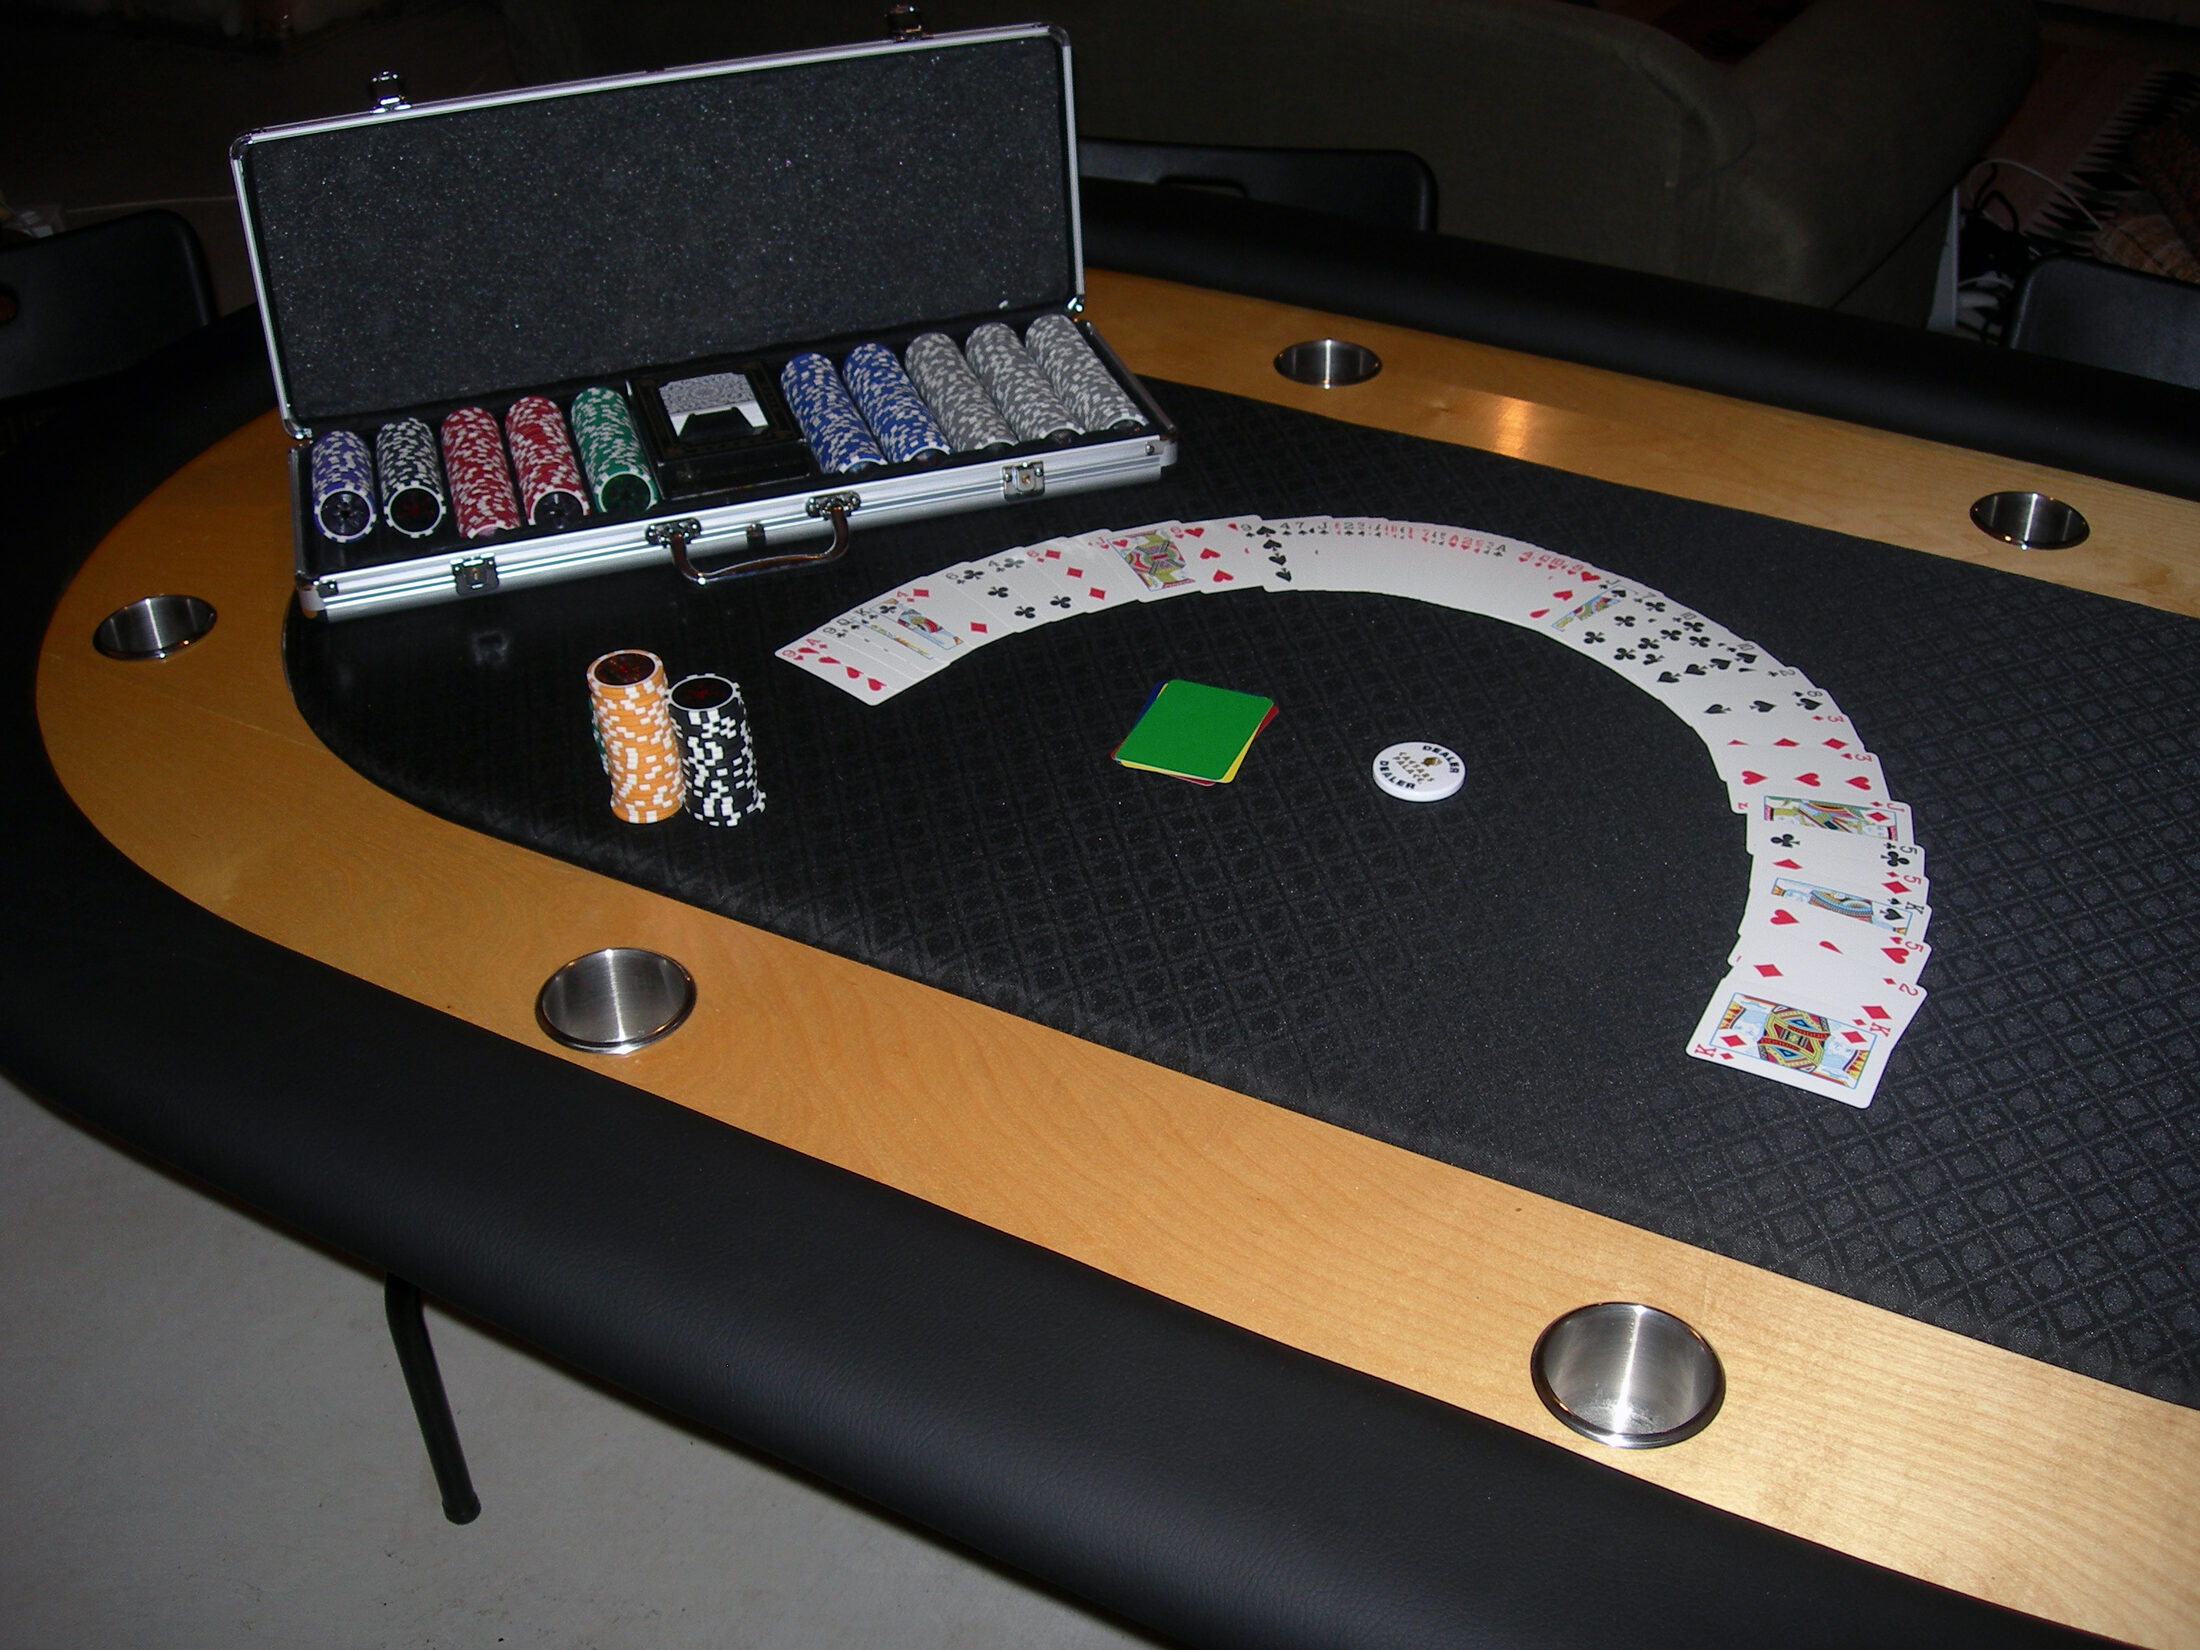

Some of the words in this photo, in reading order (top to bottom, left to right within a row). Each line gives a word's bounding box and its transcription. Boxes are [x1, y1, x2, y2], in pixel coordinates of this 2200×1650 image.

[1422, 745, 1460, 774] DEALER
[1379, 760, 1416, 789] DEALER
[1886, 802, 1905, 813] J
[1900, 845, 1918, 855] 5
[1903, 874, 1922, 885] 5
[1905, 901, 1925, 915] K
[1904, 940, 1924, 953] 5
[1898, 983, 1919, 997] 2
[1869, 1022, 1891, 1038] K
[1693, 1043, 1717, 1058] K
